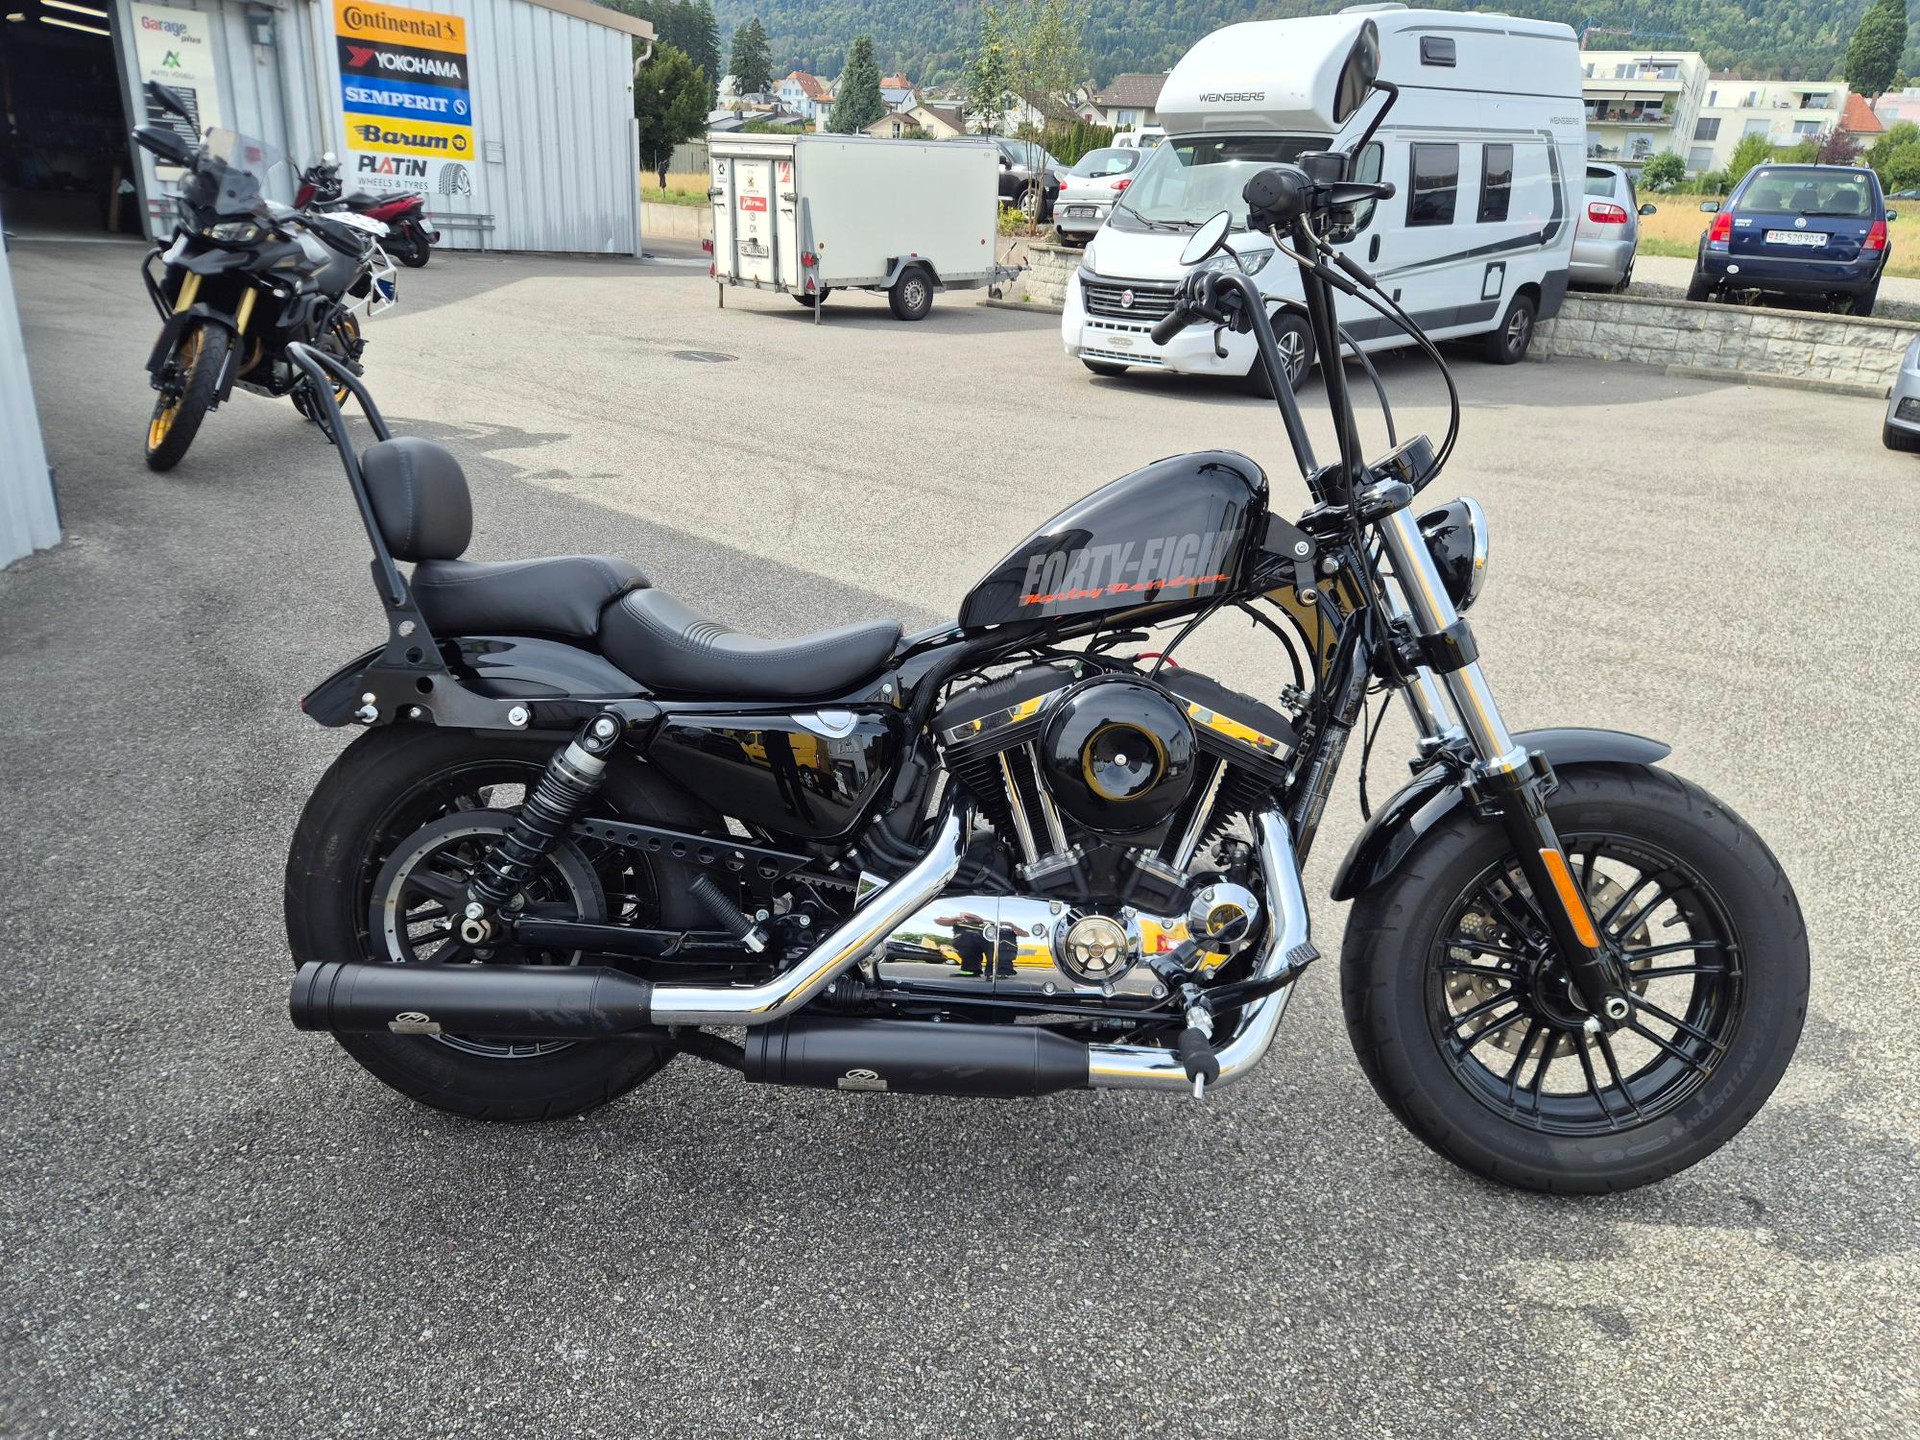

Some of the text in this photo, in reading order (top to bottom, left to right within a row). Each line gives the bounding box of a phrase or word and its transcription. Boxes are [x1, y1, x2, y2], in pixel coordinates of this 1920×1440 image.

[141, 16, 187, 37] Garage
[343, 6, 442, 39] Continental
[375, 51, 461, 79] YOKOHAMA
[345, 86, 449, 112] SEMPERIT
[360, 124, 449, 149] Barum
[357, 177, 393, 188] WHEELS
[404, 180, 429, 190] TYRES
